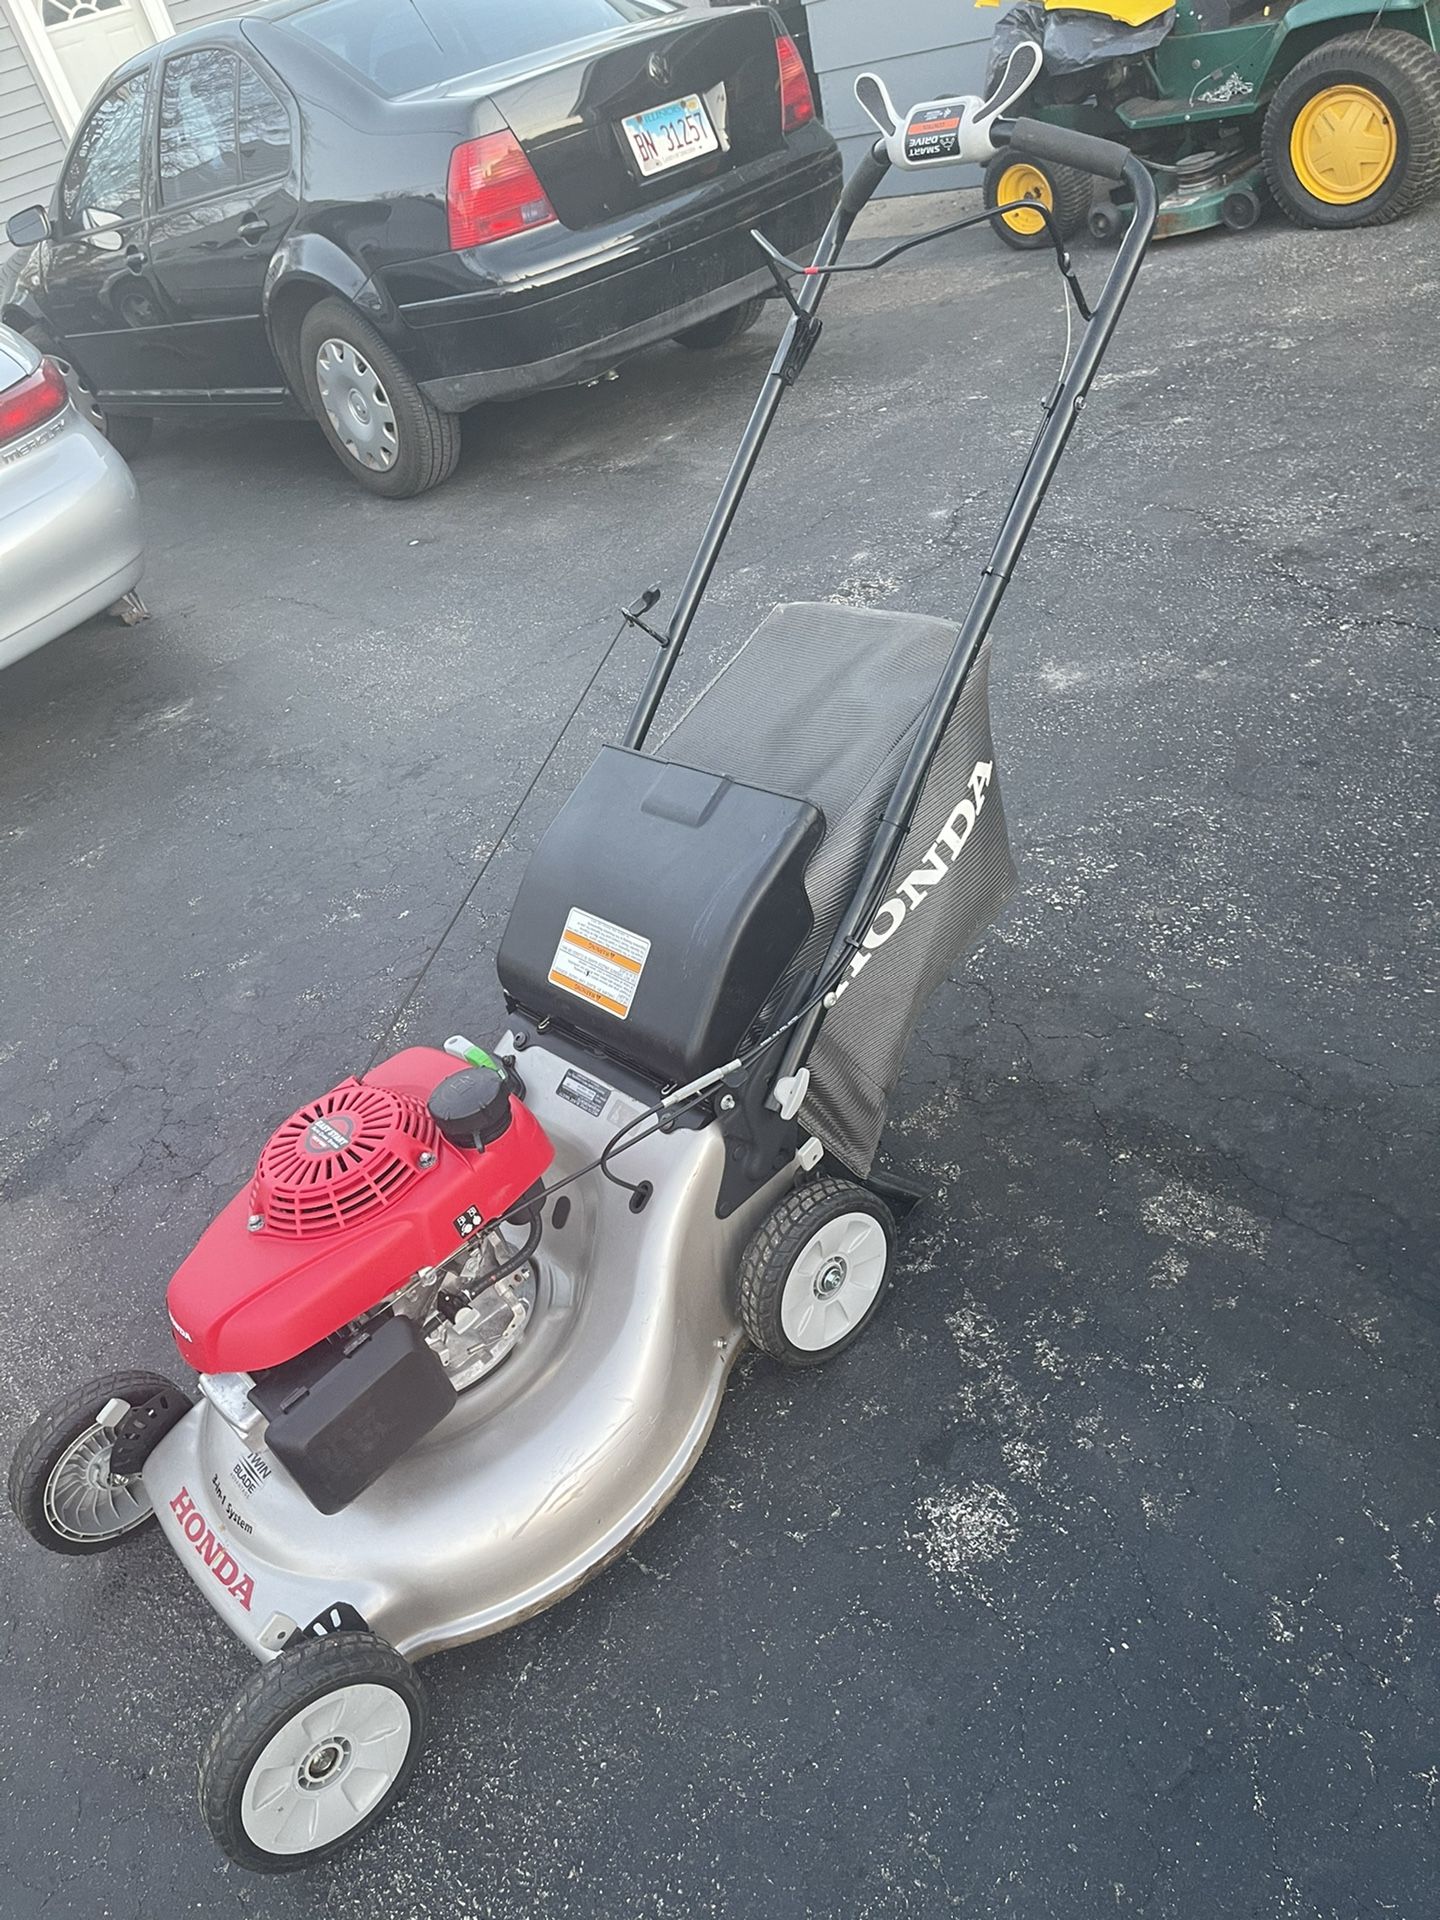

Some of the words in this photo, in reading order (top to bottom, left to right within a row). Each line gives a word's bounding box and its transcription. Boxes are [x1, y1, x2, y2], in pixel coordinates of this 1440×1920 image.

[633, 130, 659, 162] BN
[660, 112, 708, 151] 31257
[908, 135, 939, 147] DRIVE
[908, 144, 941, 157] SMART
[233, 1463, 257, 1494] BLADE
[247, 1452, 272, 1479] TWIN
[226, 1502, 253, 1535] System
[169, 1486, 256, 1612] HONDA
